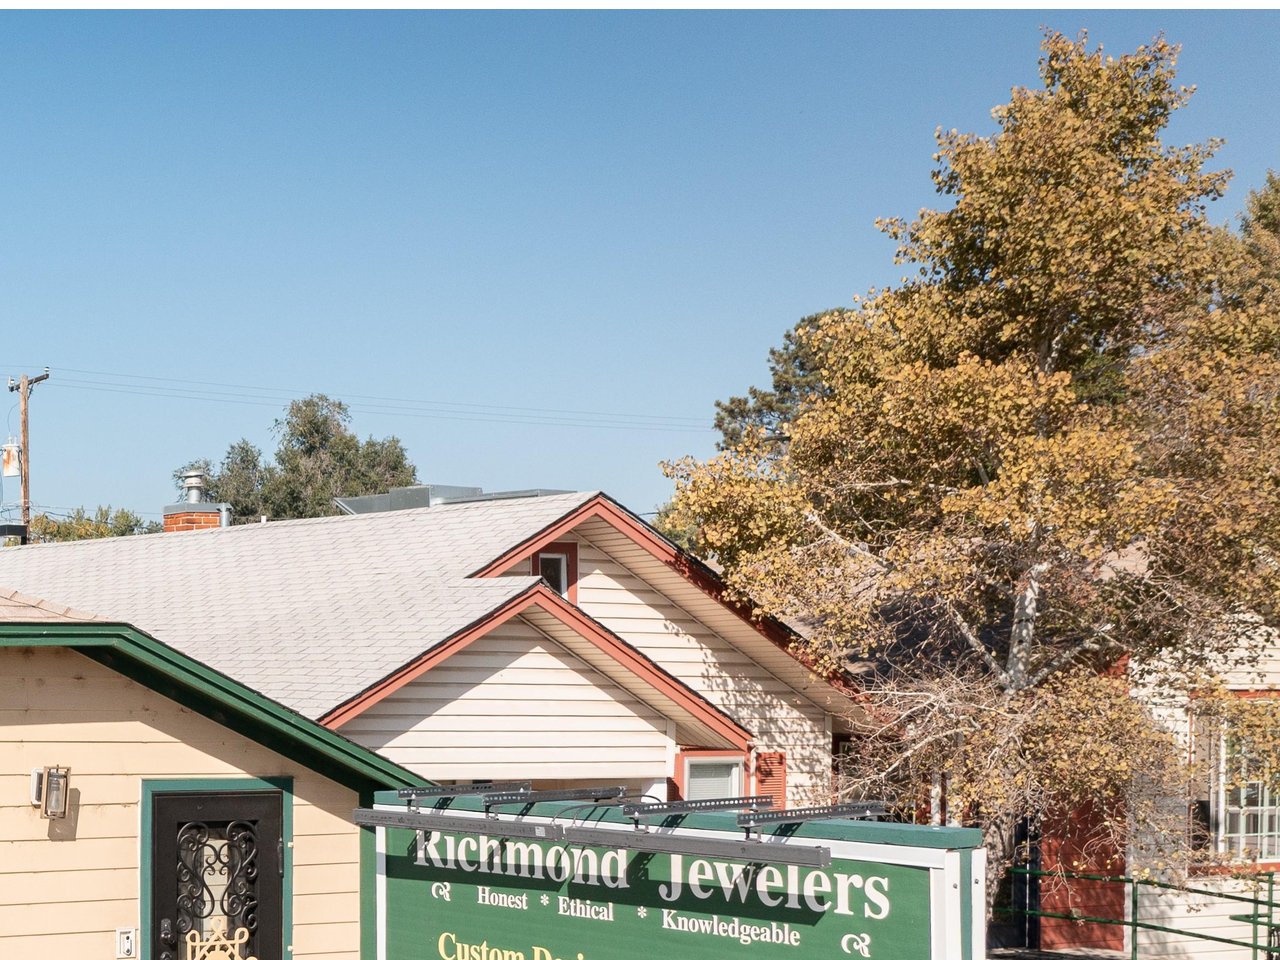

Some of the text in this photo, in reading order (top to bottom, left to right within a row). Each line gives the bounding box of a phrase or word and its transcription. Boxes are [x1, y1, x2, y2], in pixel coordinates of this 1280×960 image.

[477, 885, 801, 947] Honest Ethical Knowledgeable
